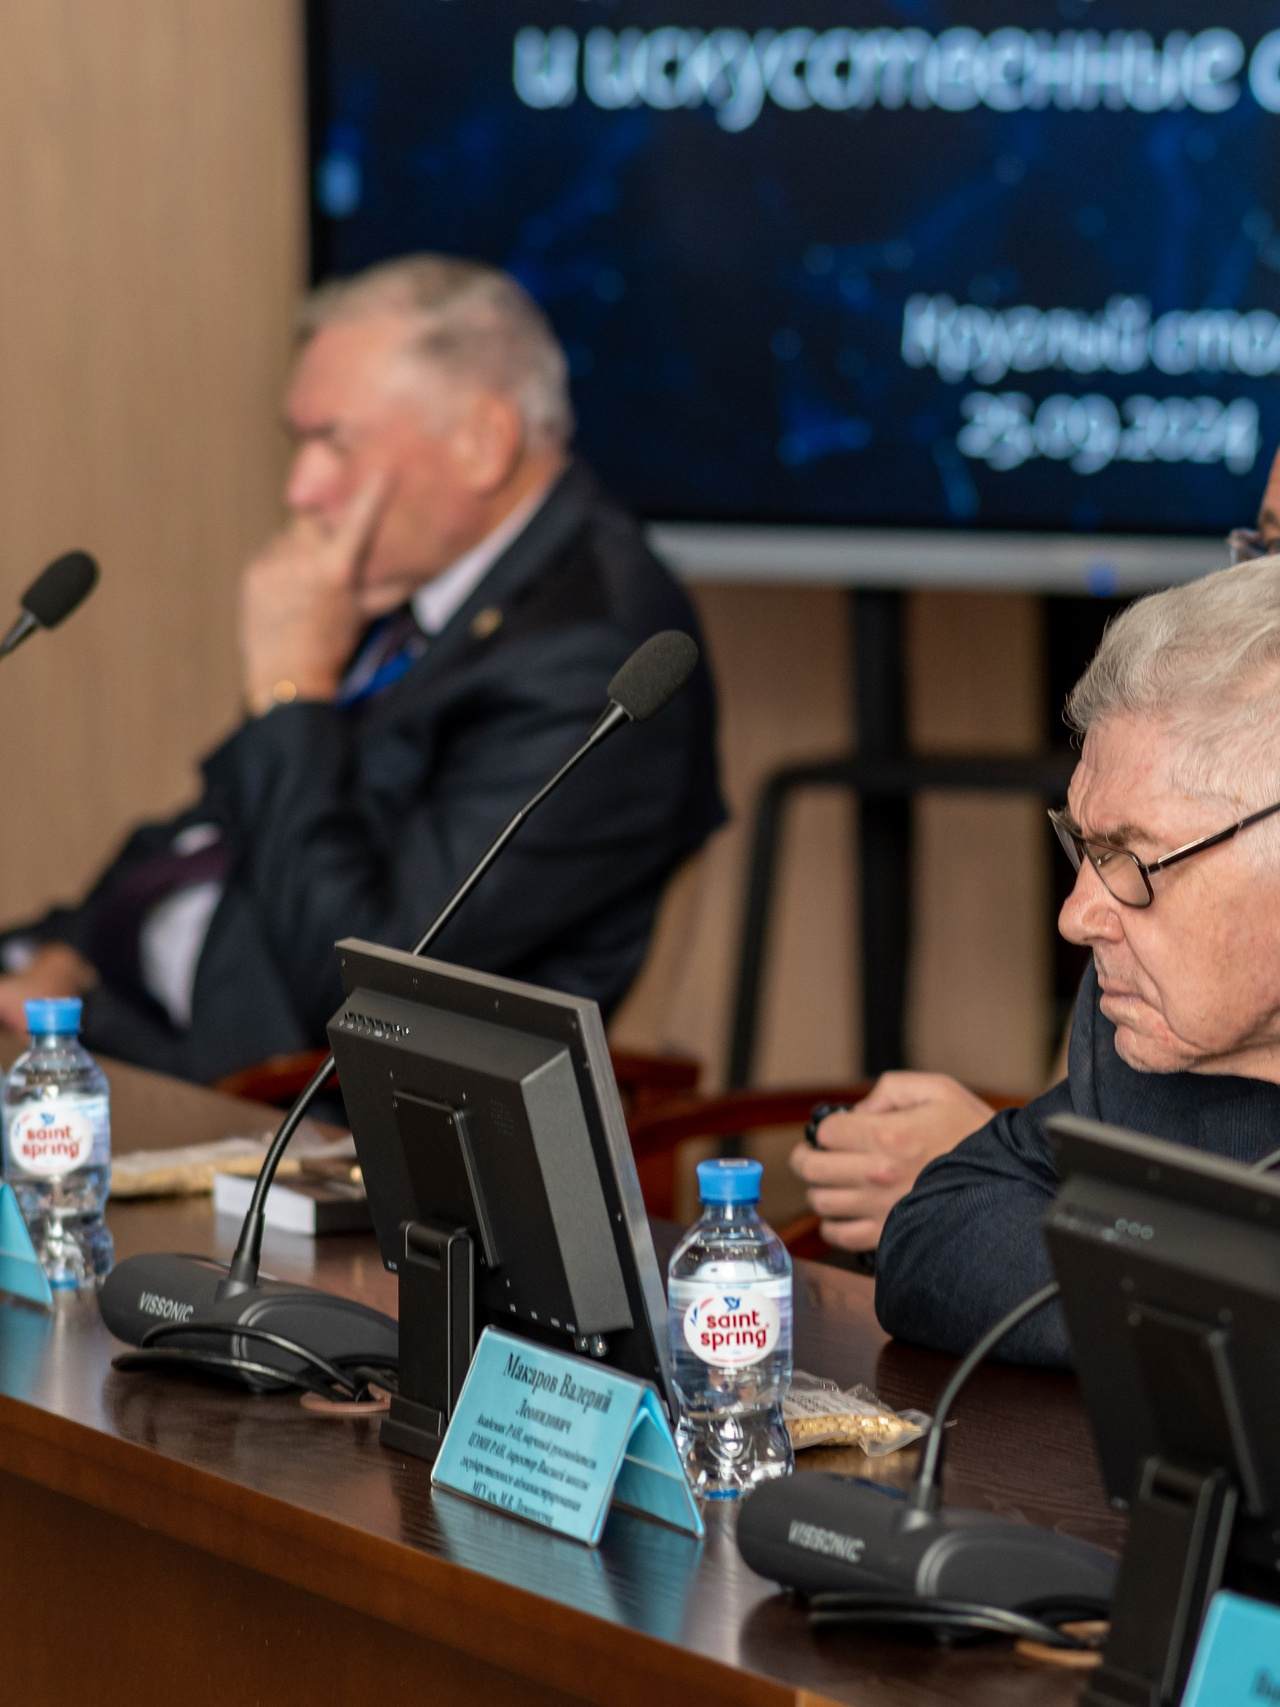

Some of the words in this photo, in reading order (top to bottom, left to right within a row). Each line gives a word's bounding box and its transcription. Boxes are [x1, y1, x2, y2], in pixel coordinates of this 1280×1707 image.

[513, 27, 578, 109] и
[584, 27, 1244, 132] искусственные
[26, 1124, 72, 1141] saint
[22, 1141, 80, 1161] spring
[139, 1291, 194, 1323] VISSONIC
[706, 1309, 760, 1329] saint
[701, 1328, 767, 1352] spring
[503, 1352, 558, 1395] Макаров
[559, 1372, 614, 1414] Валерий
[516, 1398, 572, 1434] Леонидович
